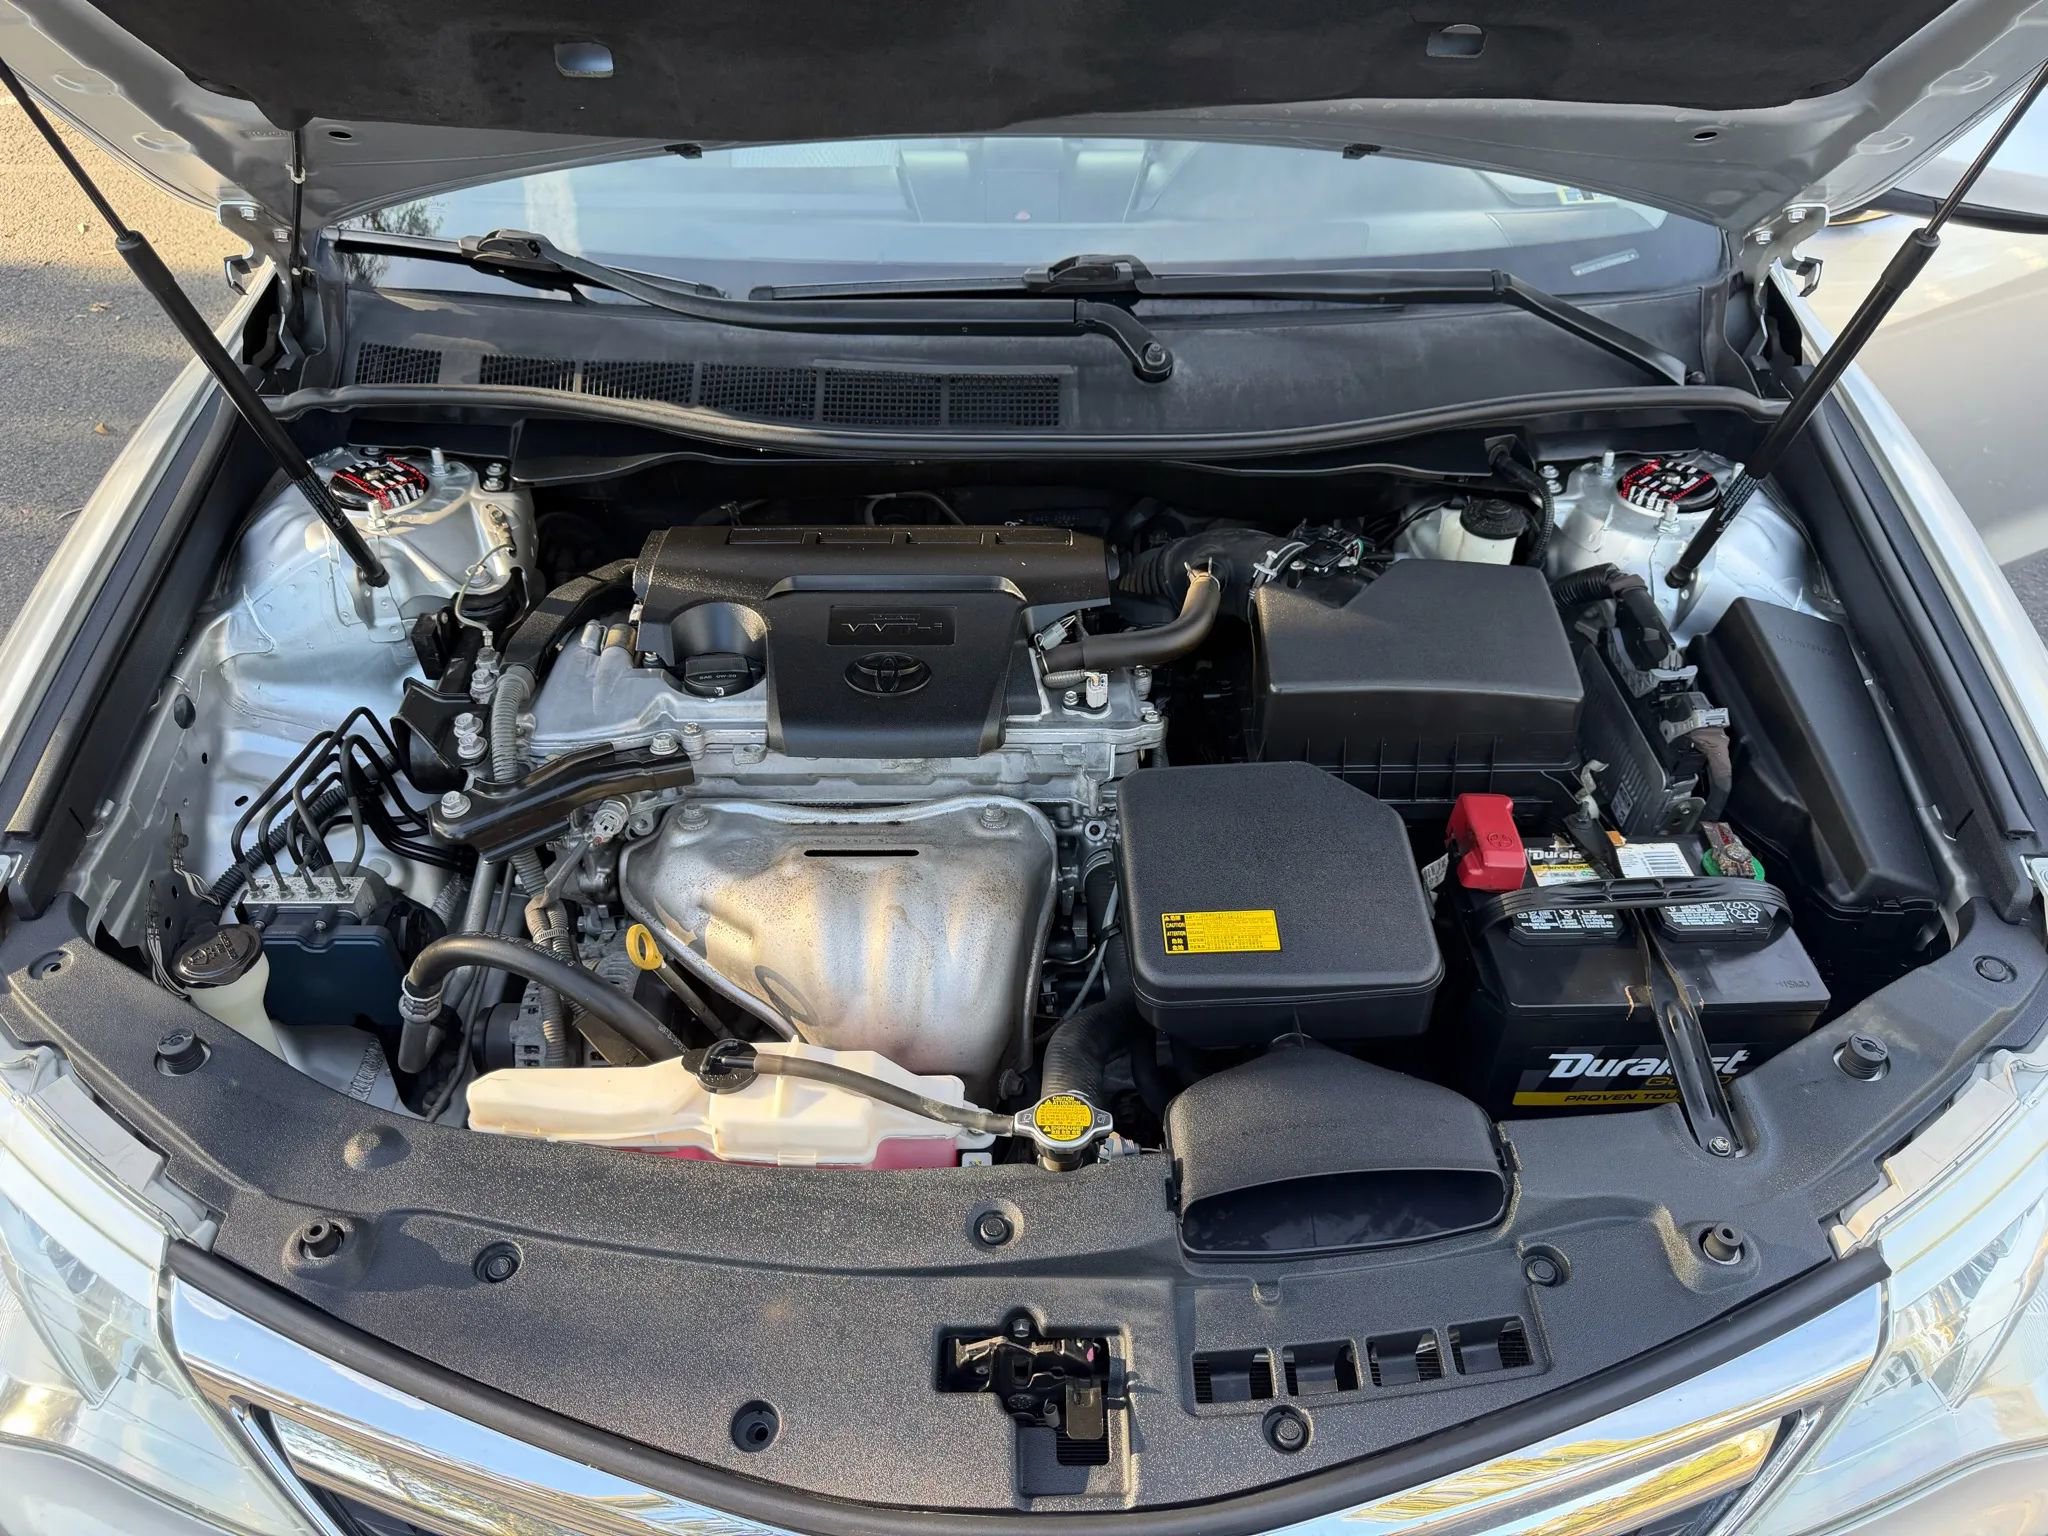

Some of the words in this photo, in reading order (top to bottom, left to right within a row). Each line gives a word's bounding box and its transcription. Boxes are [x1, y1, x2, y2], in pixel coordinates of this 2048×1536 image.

[1528, 849, 1582, 860] Durala
[1548, 1050, 1751, 1078] Duralst
[1564, 1092, 1639, 1102] PROVEN
[1643, 1092, 1680, 1101] TOU
